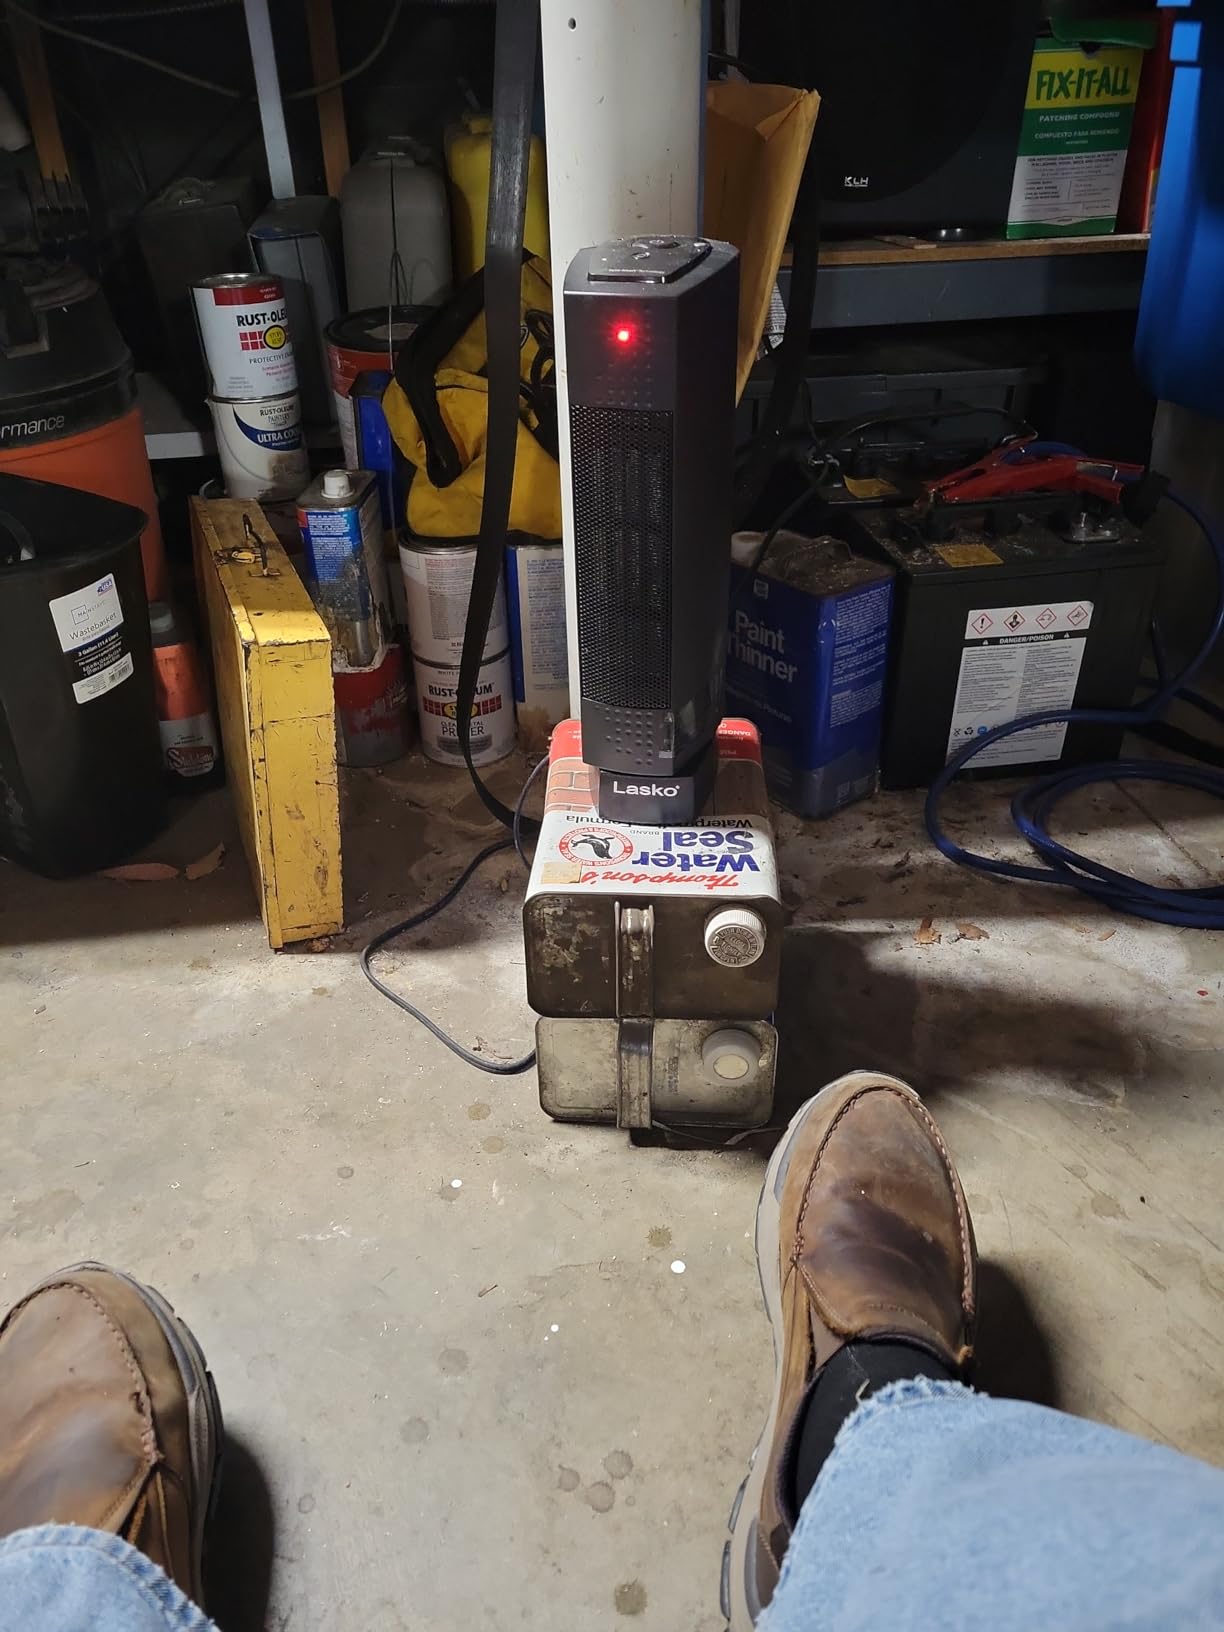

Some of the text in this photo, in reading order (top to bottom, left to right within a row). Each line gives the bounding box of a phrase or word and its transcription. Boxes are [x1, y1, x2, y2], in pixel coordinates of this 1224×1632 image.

[1035, 65, 1131, 101] FIX-IT-ALL
[1039, 111, 1120, 122] PATCHING COMPOUND
[844, 176, 869, 186] KLH
[257, 432, 283, 443] ULTRA
[69, 612, 117, 641] Wastebasket
[735, 609, 785, 654] Paint
[999, 633, 1055, 645] DANGER/POISON
[727, 631, 798, 683] Thinner
[428, 683, 494, 697] RUST-UM
[441, 720, 457, 728] CLEA
[442, 726, 485, 737] PRER
[613, 781, 678, 797] Lasko
[662, 831, 754, 854] Seal
[631, 851, 761, 872] Water
[580, 871, 740, 890] Thompson's
